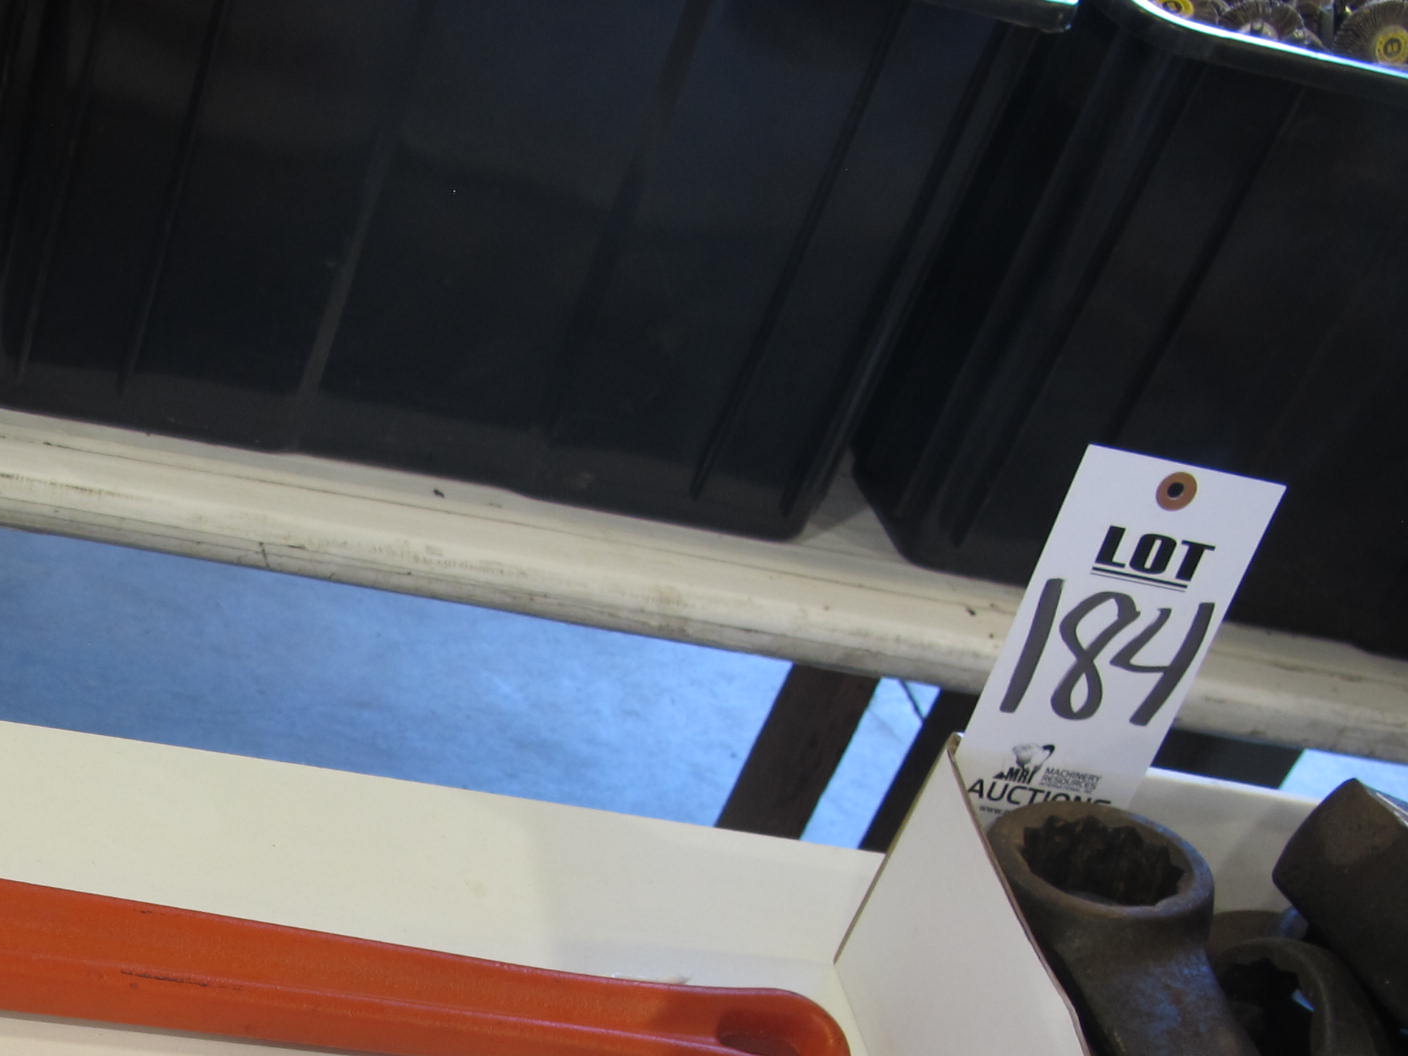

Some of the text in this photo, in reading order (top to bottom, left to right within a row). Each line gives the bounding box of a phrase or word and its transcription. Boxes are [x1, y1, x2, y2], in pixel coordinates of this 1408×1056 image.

[1095, 525, 1216, 582] LOT
[1000, 577, 1215, 726] 184
[968, 778, 1112, 805] AUCTI
